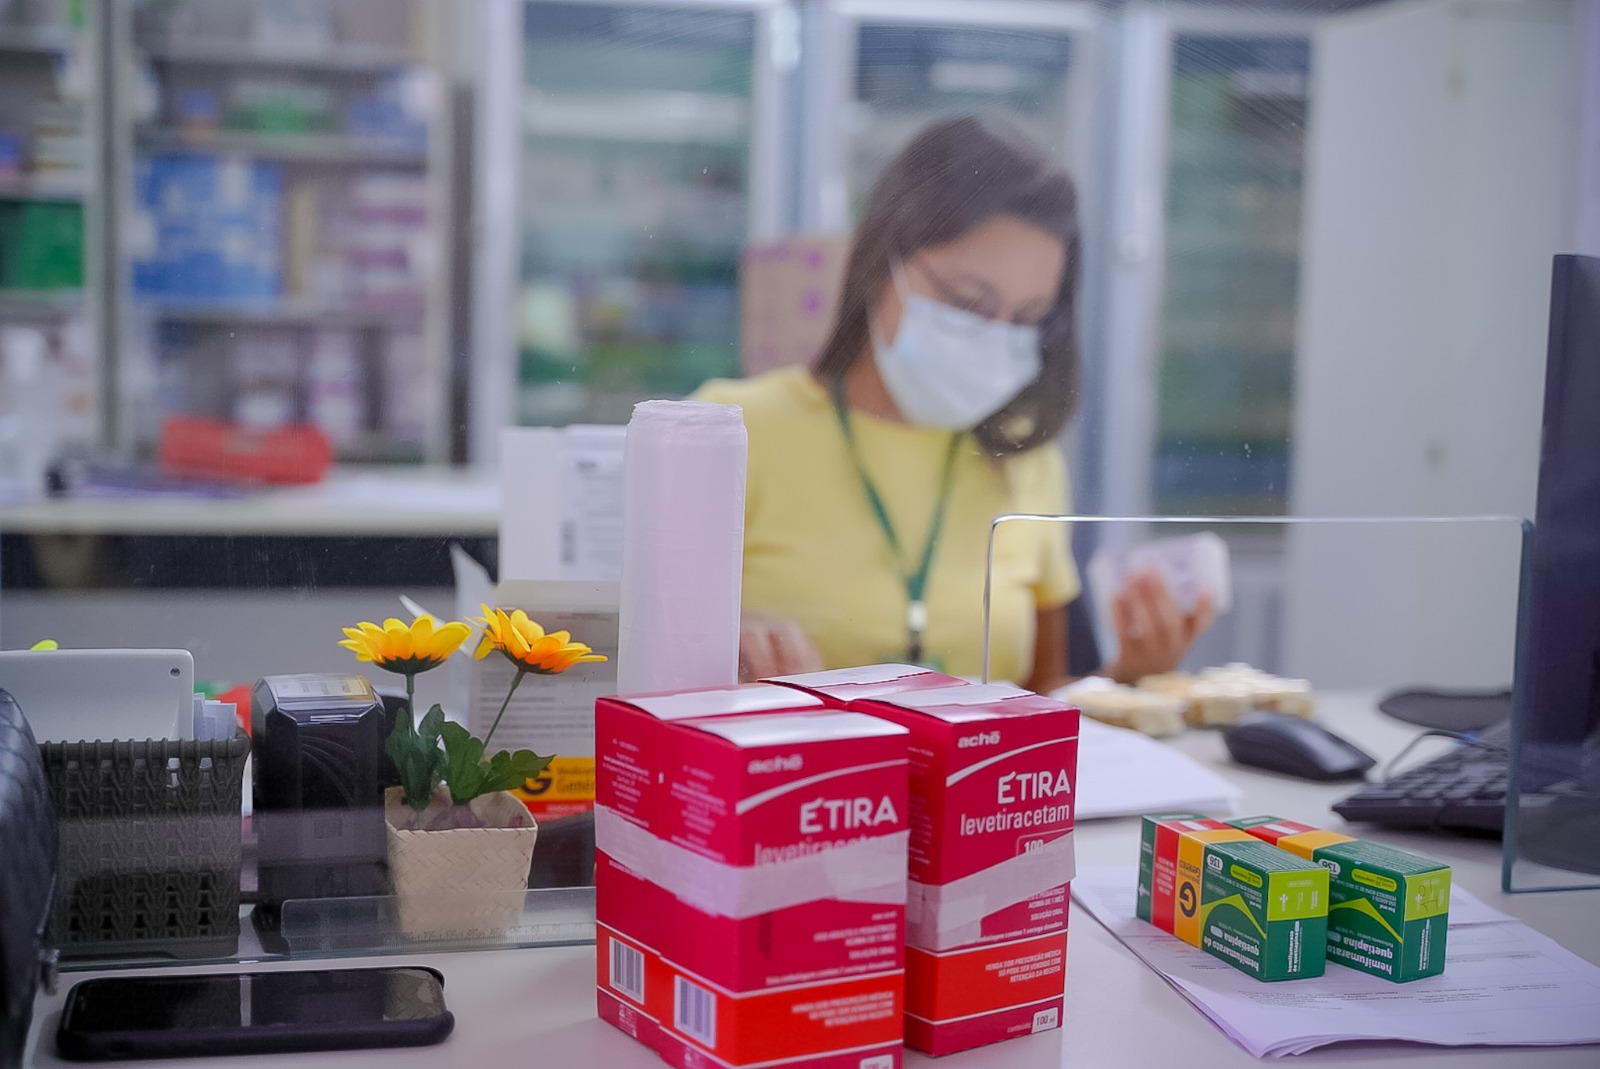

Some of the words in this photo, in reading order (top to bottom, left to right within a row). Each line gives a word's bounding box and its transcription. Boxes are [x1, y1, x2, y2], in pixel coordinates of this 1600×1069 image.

[998, 768, 1071, 804] ÉTIRA
[800, 796, 898, 834] ÉTIRA
[960, 804, 1070, 836] levetiracetam
[1180, 882, 1196, 918] G
[1327, 945, 1392, 974] hemifumarato
[1344, 937, 1393, 959] quetiapina
[1037, 1015, 1048, 1026] 100
